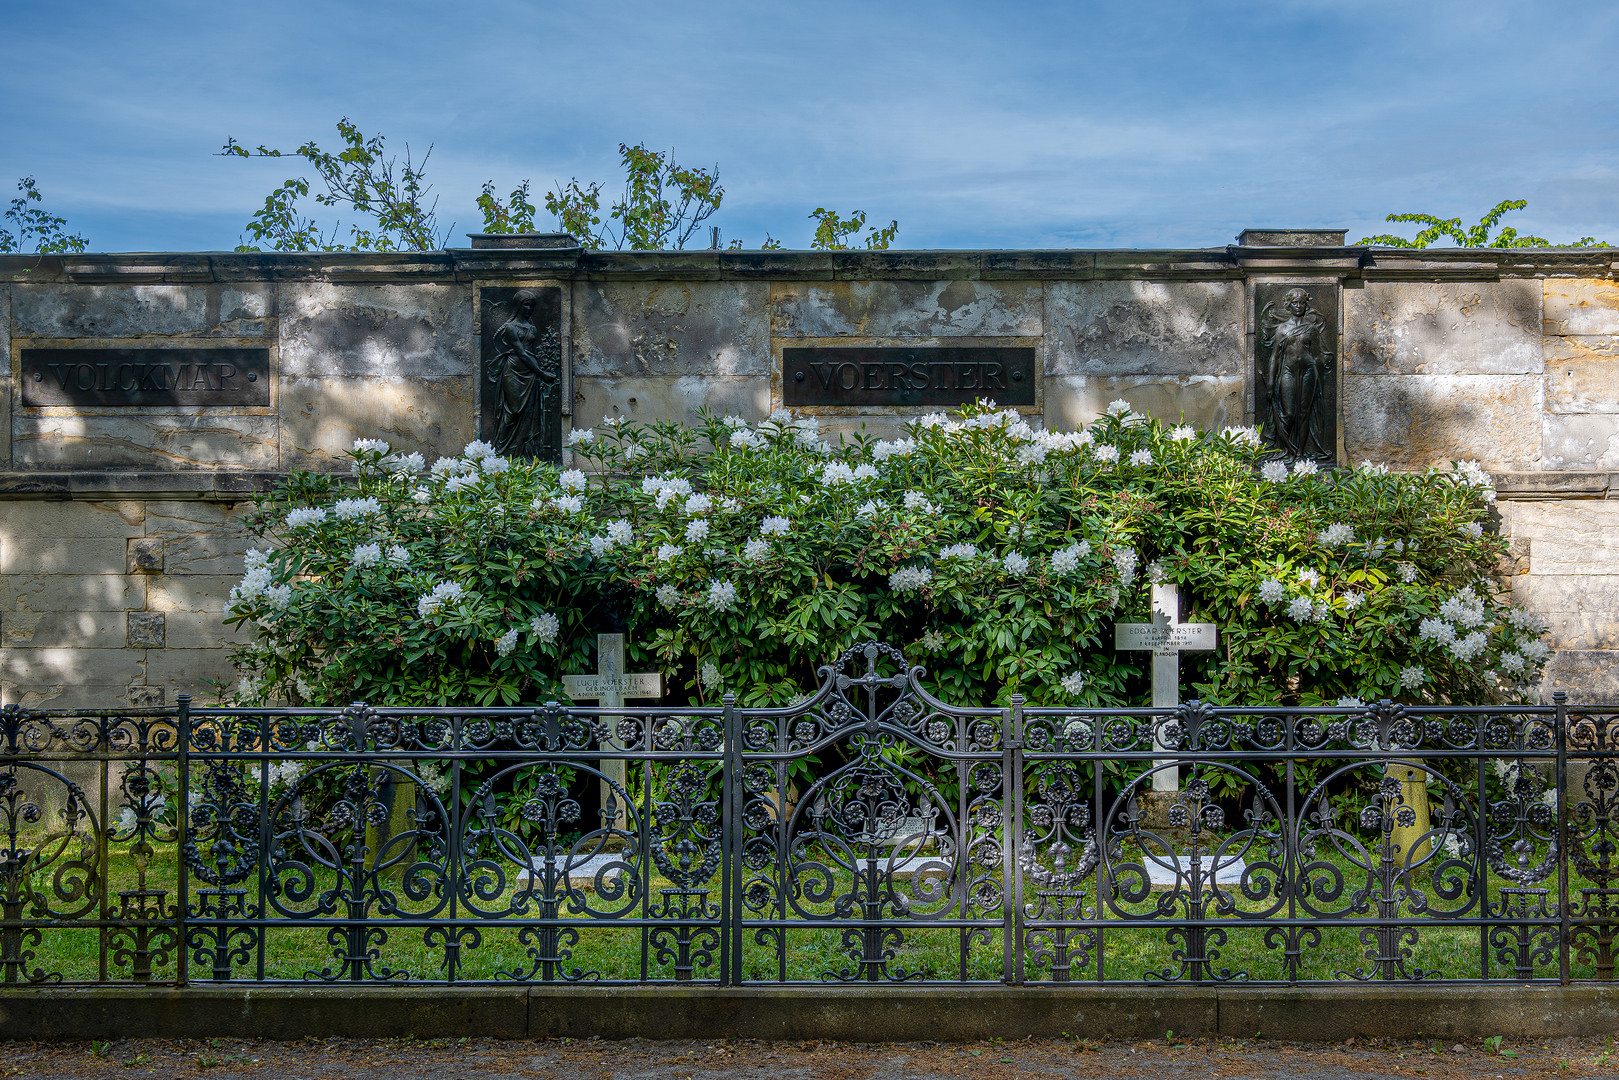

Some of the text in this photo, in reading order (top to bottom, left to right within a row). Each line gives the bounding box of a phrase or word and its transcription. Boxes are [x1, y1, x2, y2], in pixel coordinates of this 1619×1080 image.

[47, 362, 239, 391] VOLCKMAR
[810, 361, 1006, 390] VOERSTER
[1129, 627, 1202, 635] EDGAR VOERSTER
[576, 678, 645, 687] LUCIE VOERSTER
